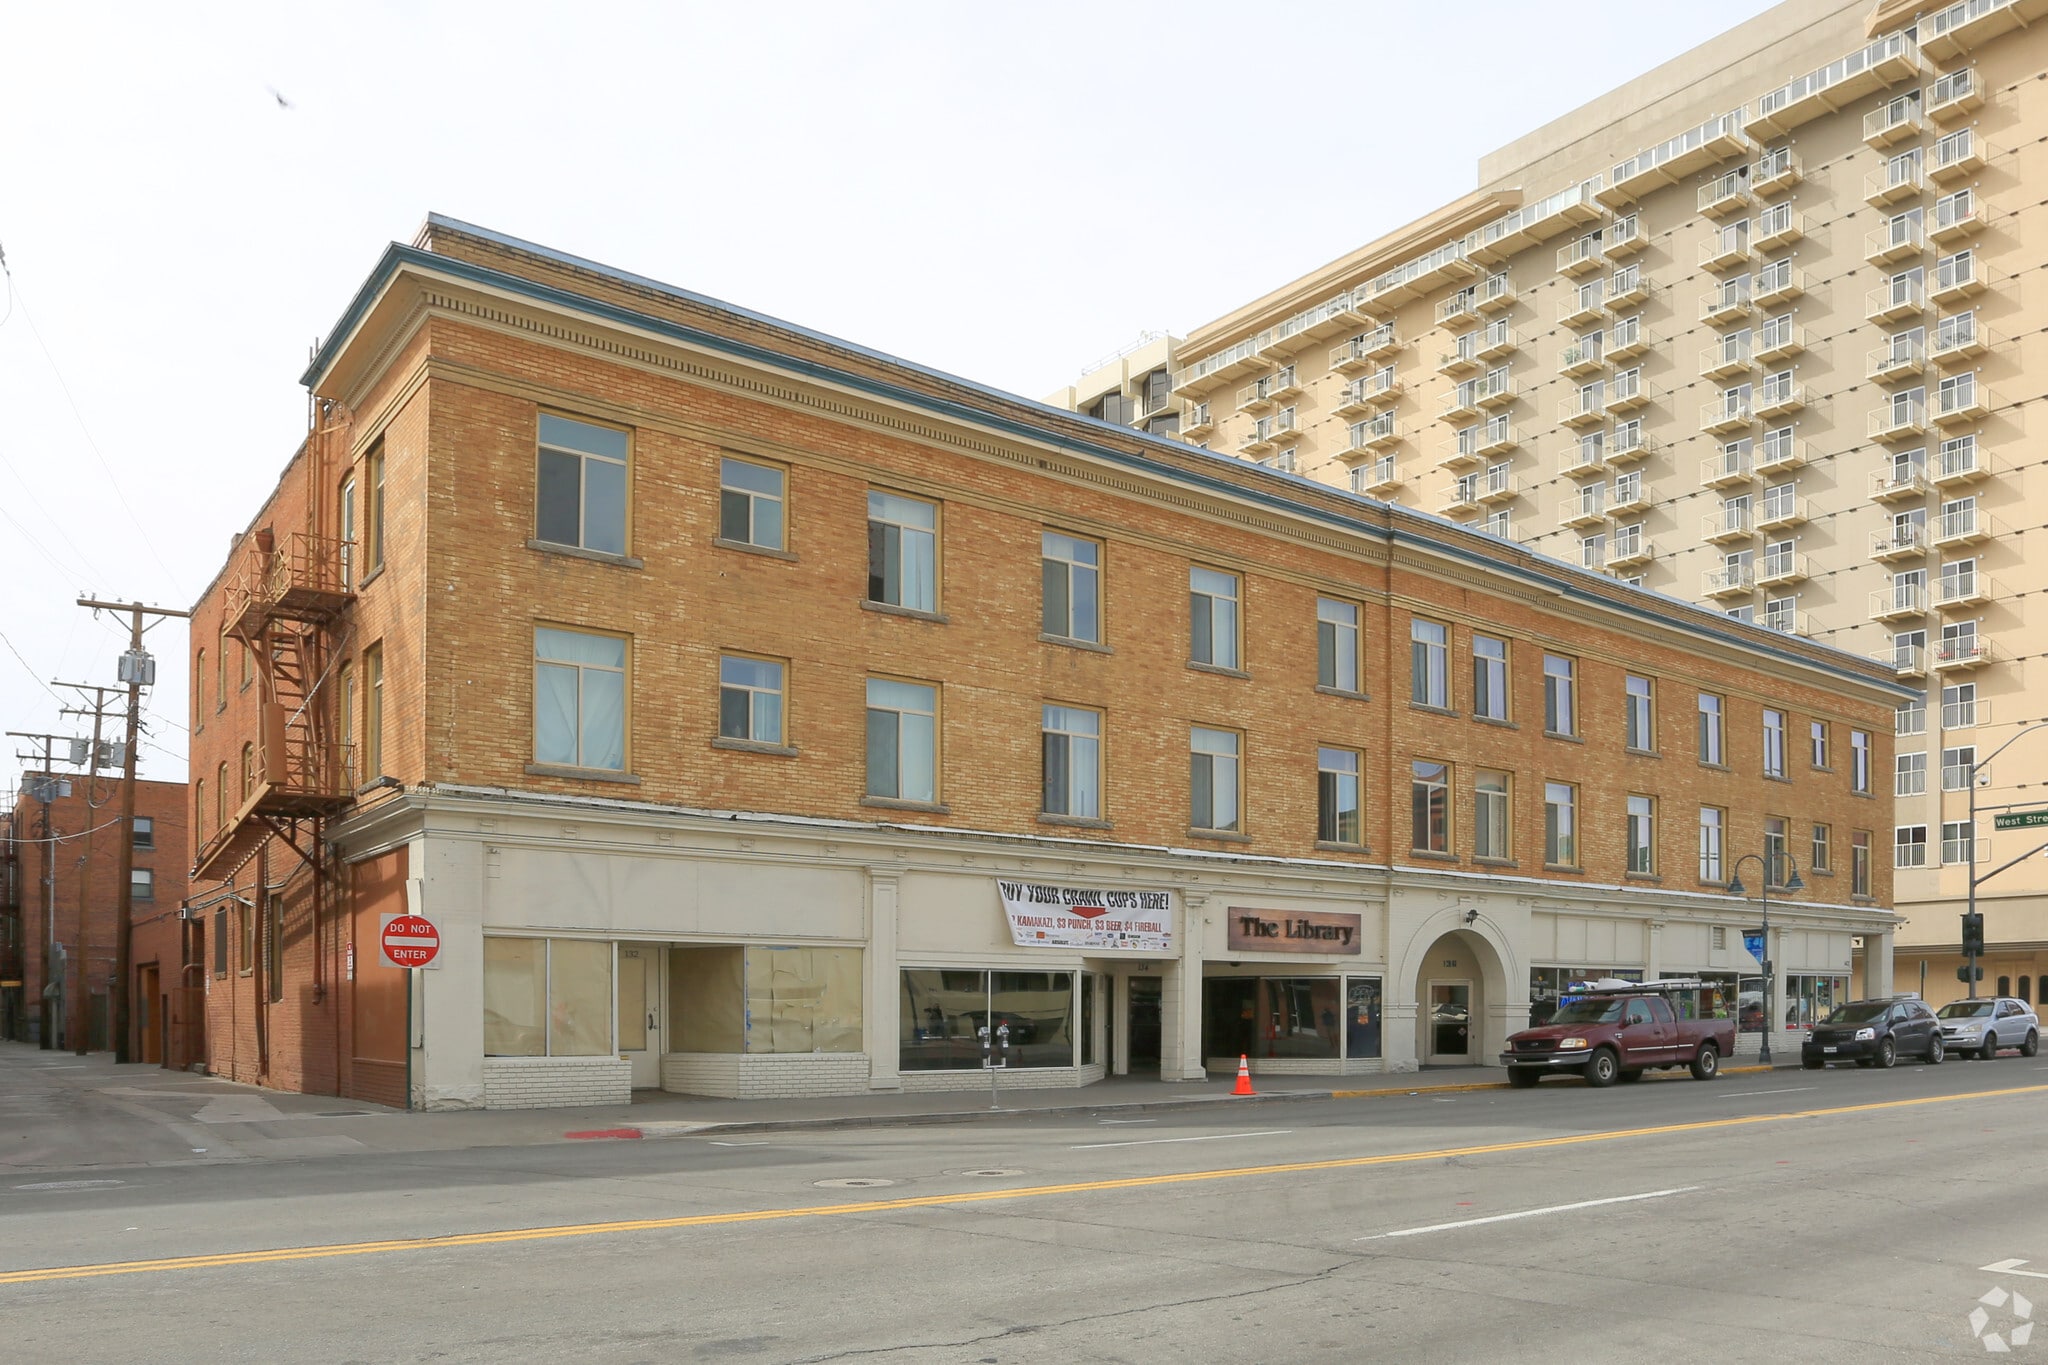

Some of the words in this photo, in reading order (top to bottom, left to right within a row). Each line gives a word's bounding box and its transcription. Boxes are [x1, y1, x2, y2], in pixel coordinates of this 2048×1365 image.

[1996, 817, 2021, 826] West
[1026, 884, 1060, 905] YOUR
[1062, 888, 1106, 907] CRAWL
[1106, 891, 1138, 909] CUPS
[1139, 892, 1169, 910] HERE!
[389, 923, 405, 933] DO
[410, 924, 432, 934] NOT
[1057, 917, 1066, 929] $3
[1067, 918, 1093, 931] PUNCH,
[1095, 919, 1105, 931] $3
[1134, 921, 1162, 933] FIREBALL
[1240, 916, 1279, 938] The
[1285, 918, 1354, 946] Library
[393, 949, 427, 959] ENTER
[624, 950, 639, 958] 132
